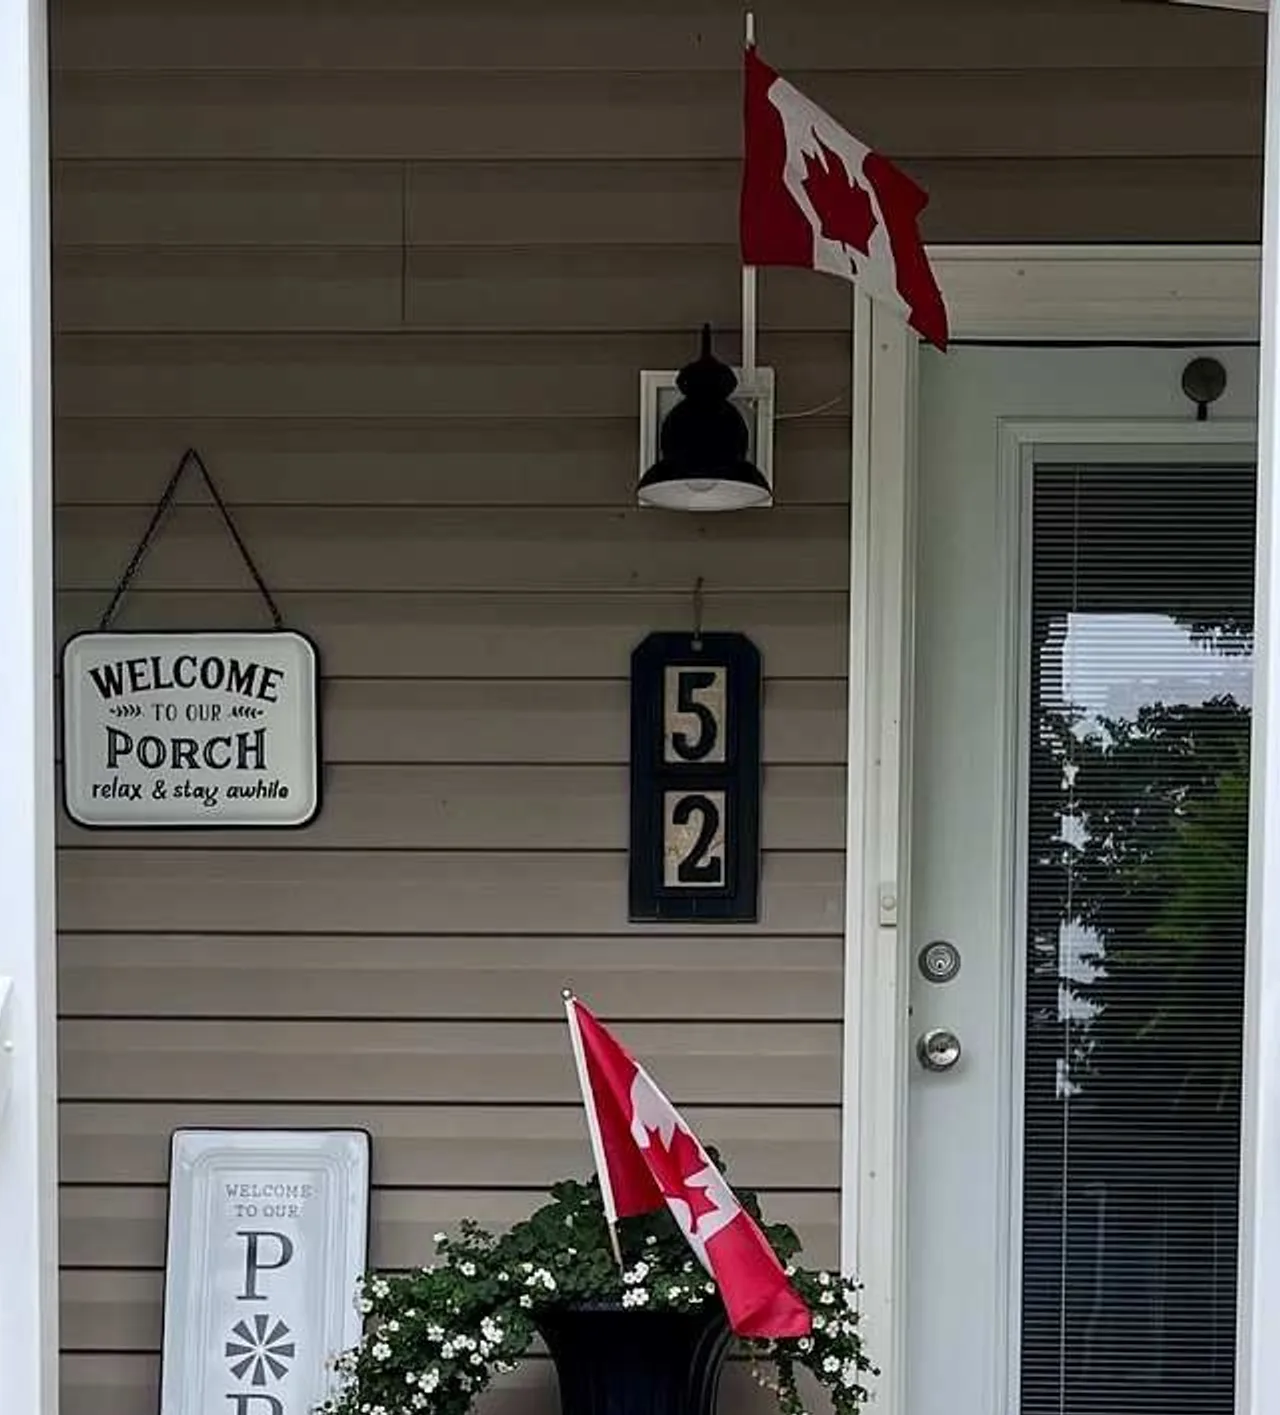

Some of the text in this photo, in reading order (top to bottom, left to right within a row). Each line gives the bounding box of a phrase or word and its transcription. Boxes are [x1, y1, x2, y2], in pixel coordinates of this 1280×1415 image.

[88, 655, 285, 703] WELCOME
[151, 703, 222, 722] TO OUR
[105, 725, 268, 770] PORCH
[92, 776, 290, 807] relax & stay awhile
[671, 671, 722, 883] 52
[225, 1183, 313, 1198] WELCOME
[234, 1203, 302, 1218] TO OUR
